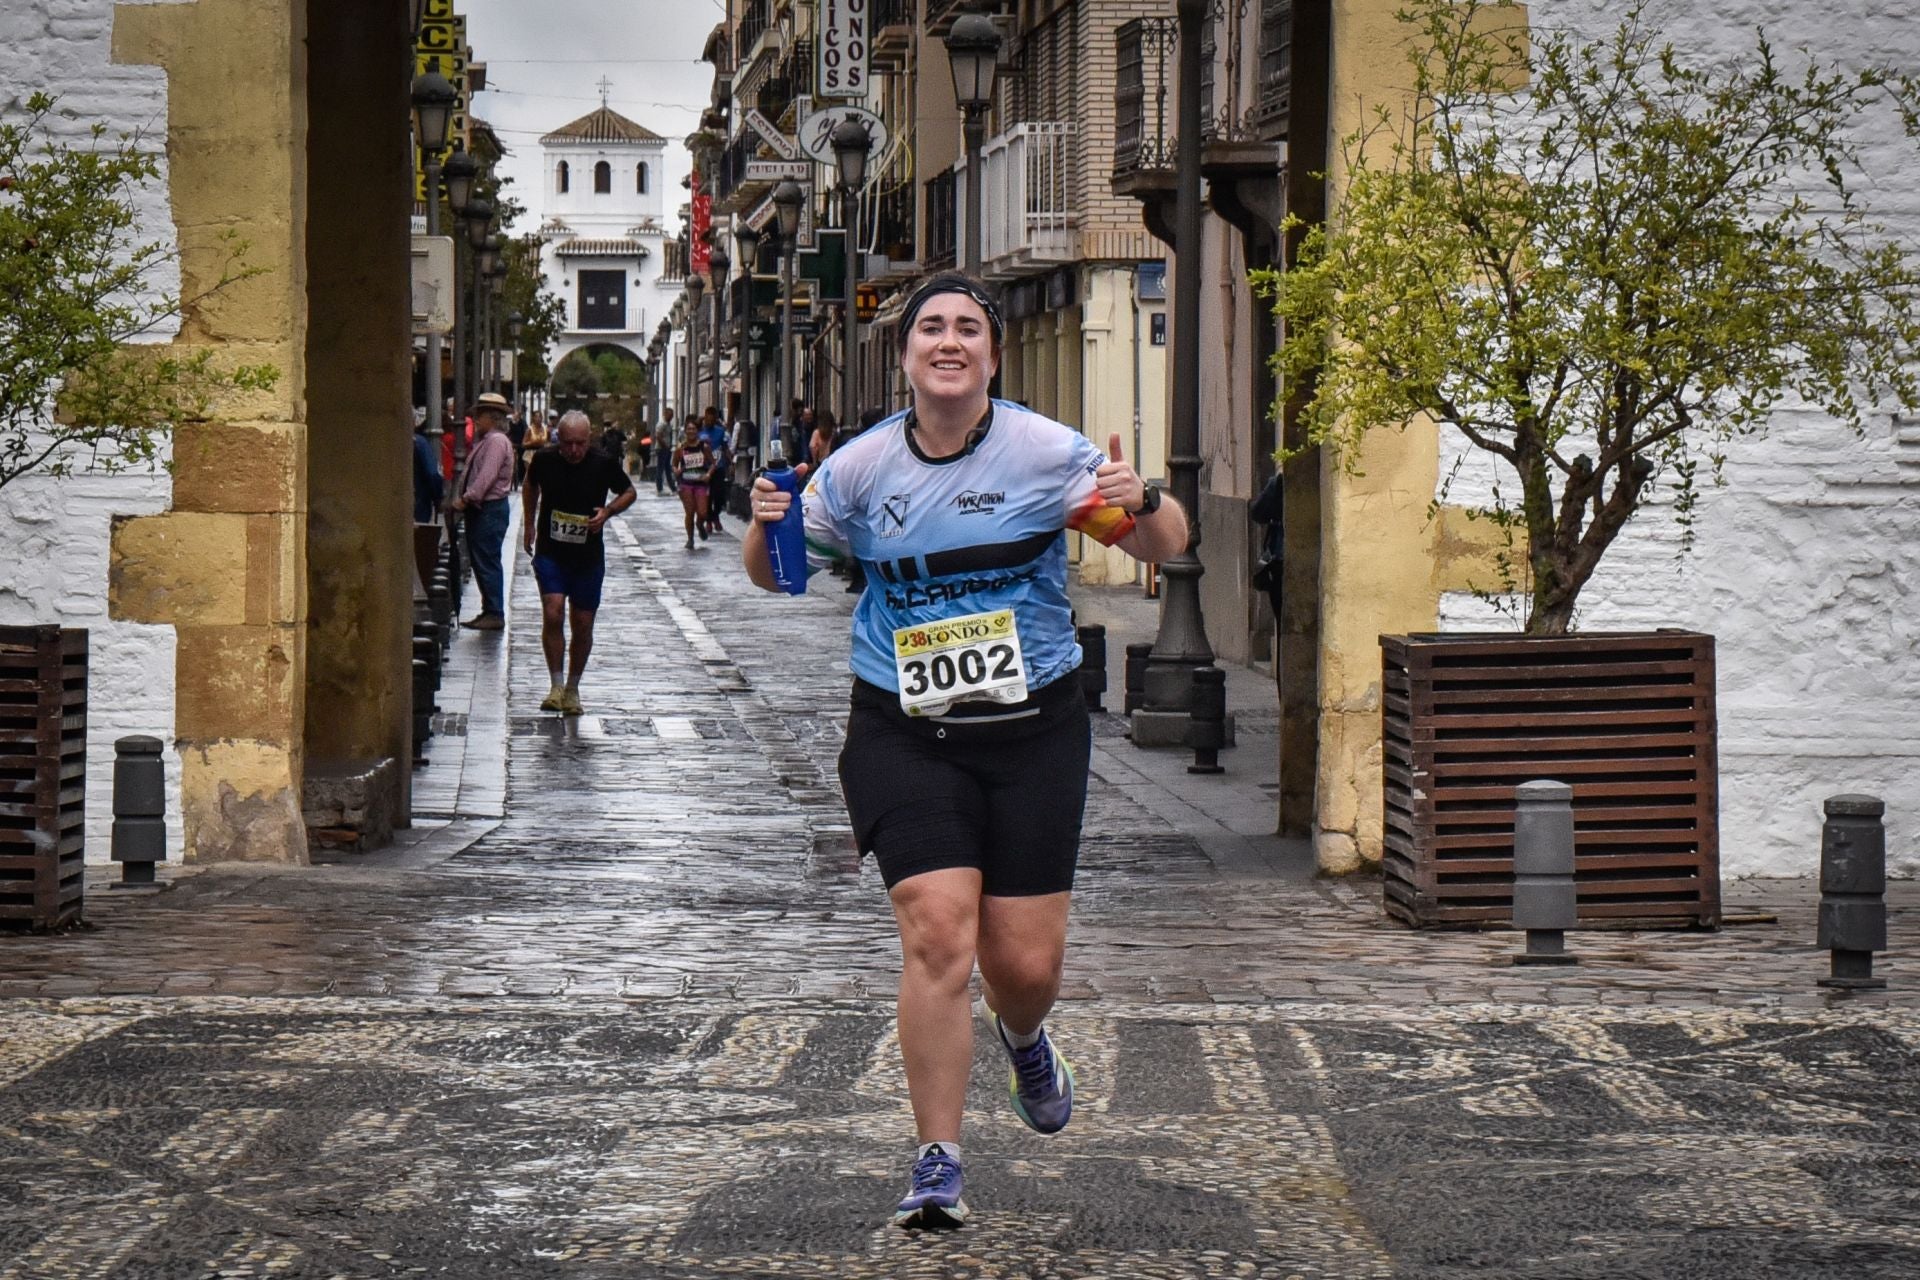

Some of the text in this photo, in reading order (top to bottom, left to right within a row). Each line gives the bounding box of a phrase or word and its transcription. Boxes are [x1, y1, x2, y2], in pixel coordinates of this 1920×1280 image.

[957, 491, 1006, 509] MARATHON
[551, 520, 587, 537] 3122
[928, 622, 951, 634] GRAN
[951, 618, 982, 631] PREMIO
[908, 630, 928, 648] 38
[926, 624, 990, 647] FONDO
[902, 643, 1020, 697] 3002
